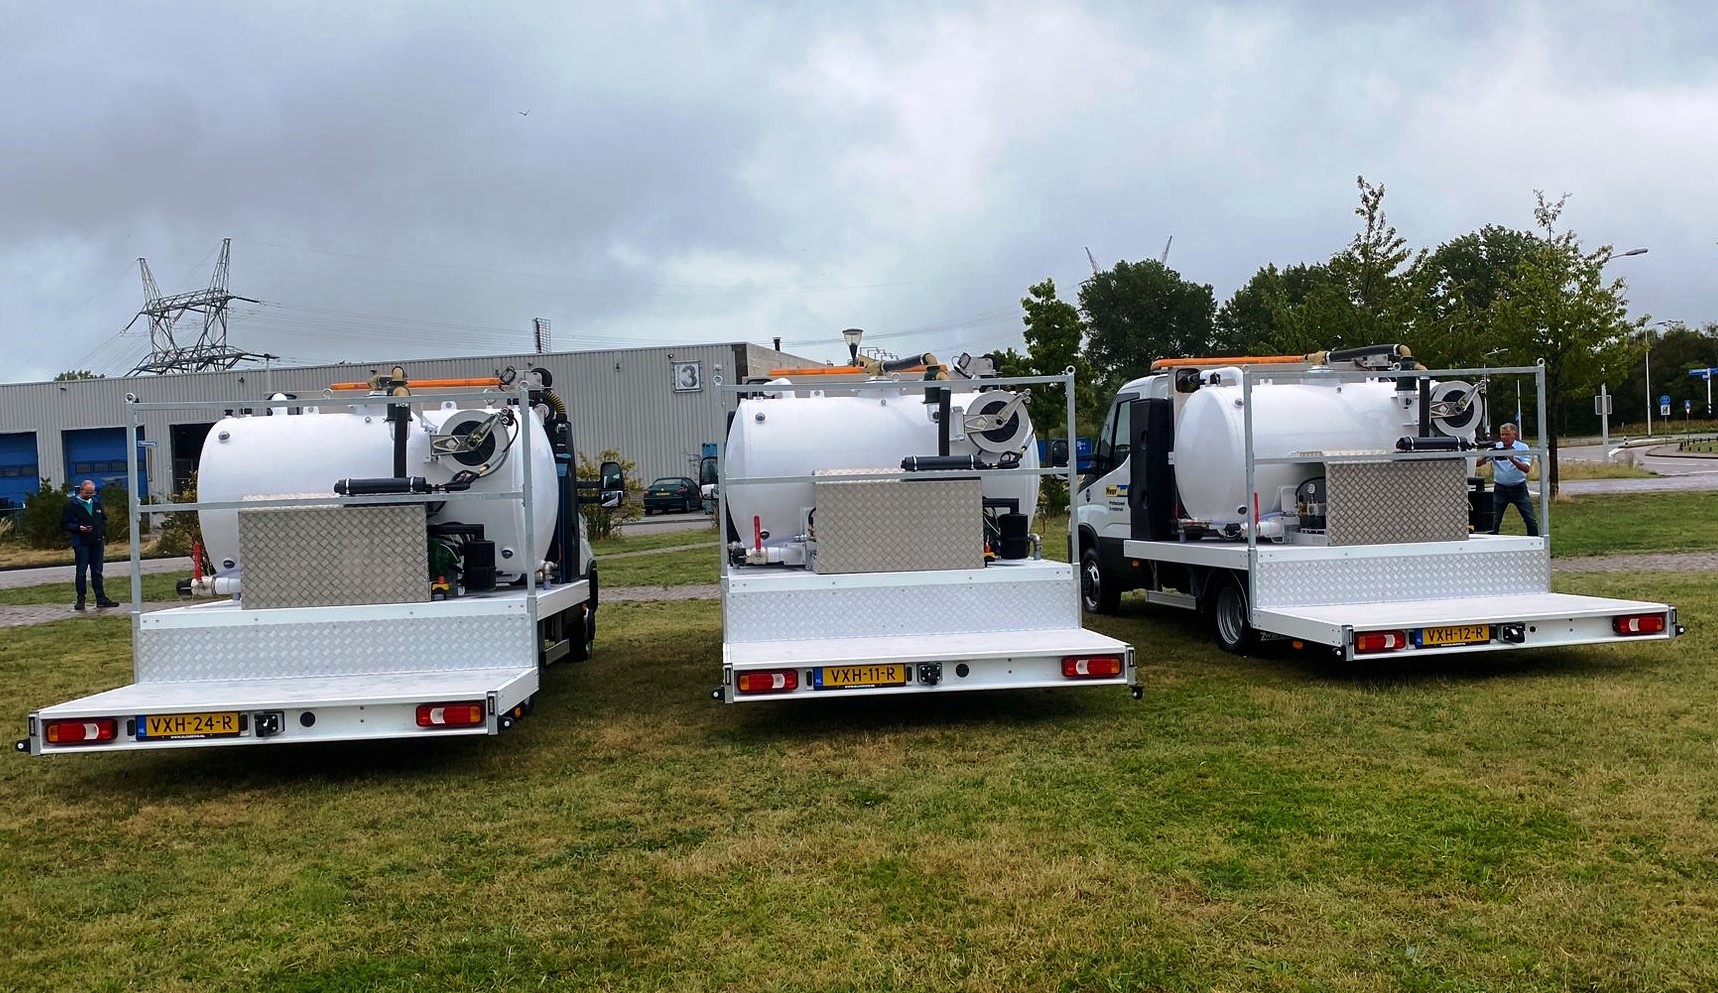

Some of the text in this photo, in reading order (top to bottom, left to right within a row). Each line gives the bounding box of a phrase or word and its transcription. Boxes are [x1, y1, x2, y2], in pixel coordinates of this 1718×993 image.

[682, 365, 697, 387] 3
[1427, 626, 1484, 642] VXH-12-R
[831, 667, 896, 683] VXH-11-R
[150, 715, 233, 733] VXH-24-R
